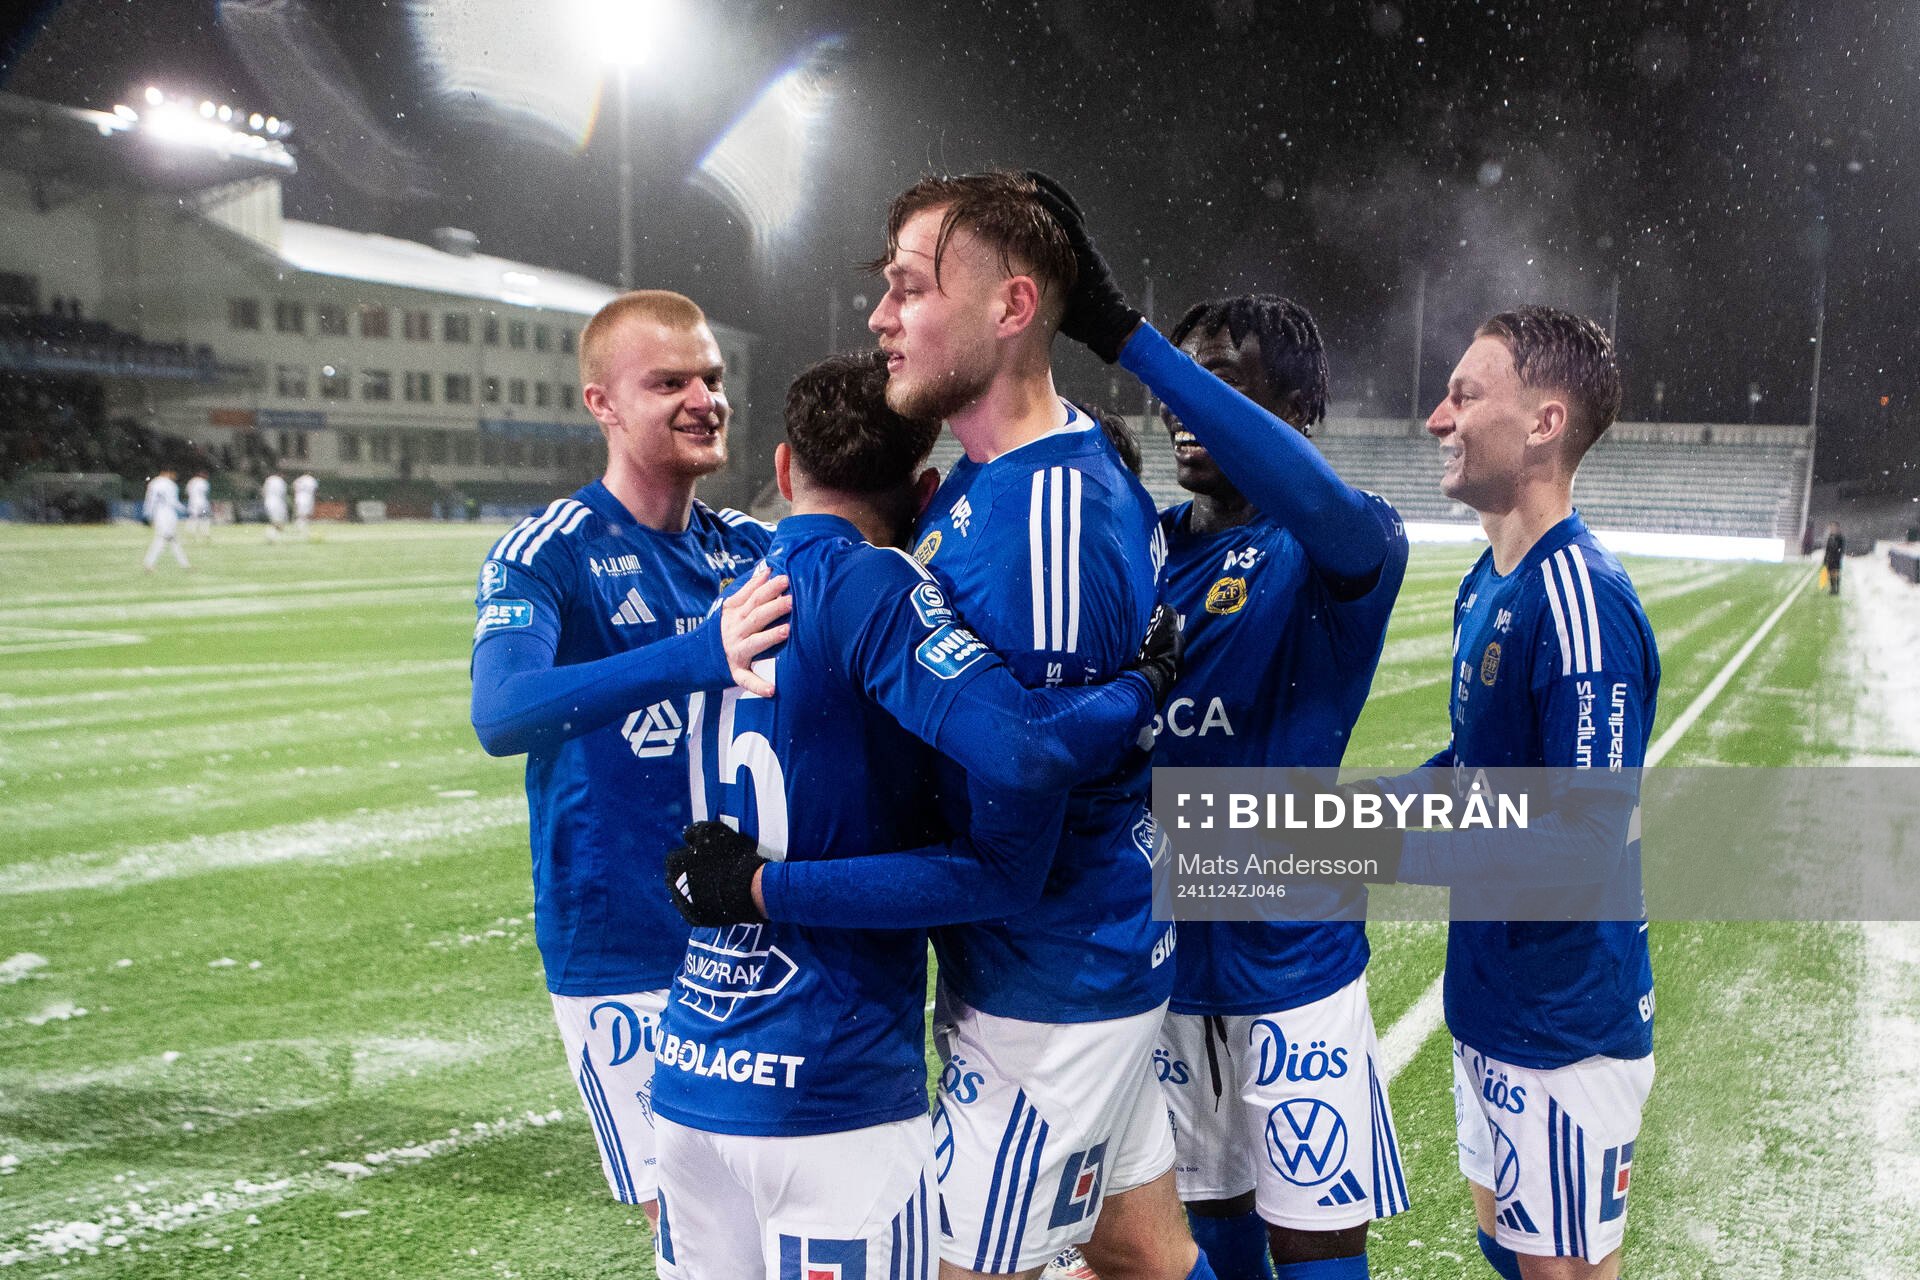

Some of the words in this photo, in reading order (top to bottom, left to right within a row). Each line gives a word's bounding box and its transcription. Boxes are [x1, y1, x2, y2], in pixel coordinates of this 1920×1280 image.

[601, 554, 642, 573] LILIUM
[687, 657, 789, 862] 15
[1576, 680, 1596, 770] stadium
[1607, 683, 1627, 773] stadium
[589, 1001, 659, 1066] Di
[1249, 1018, 1348, 1086] Diös
